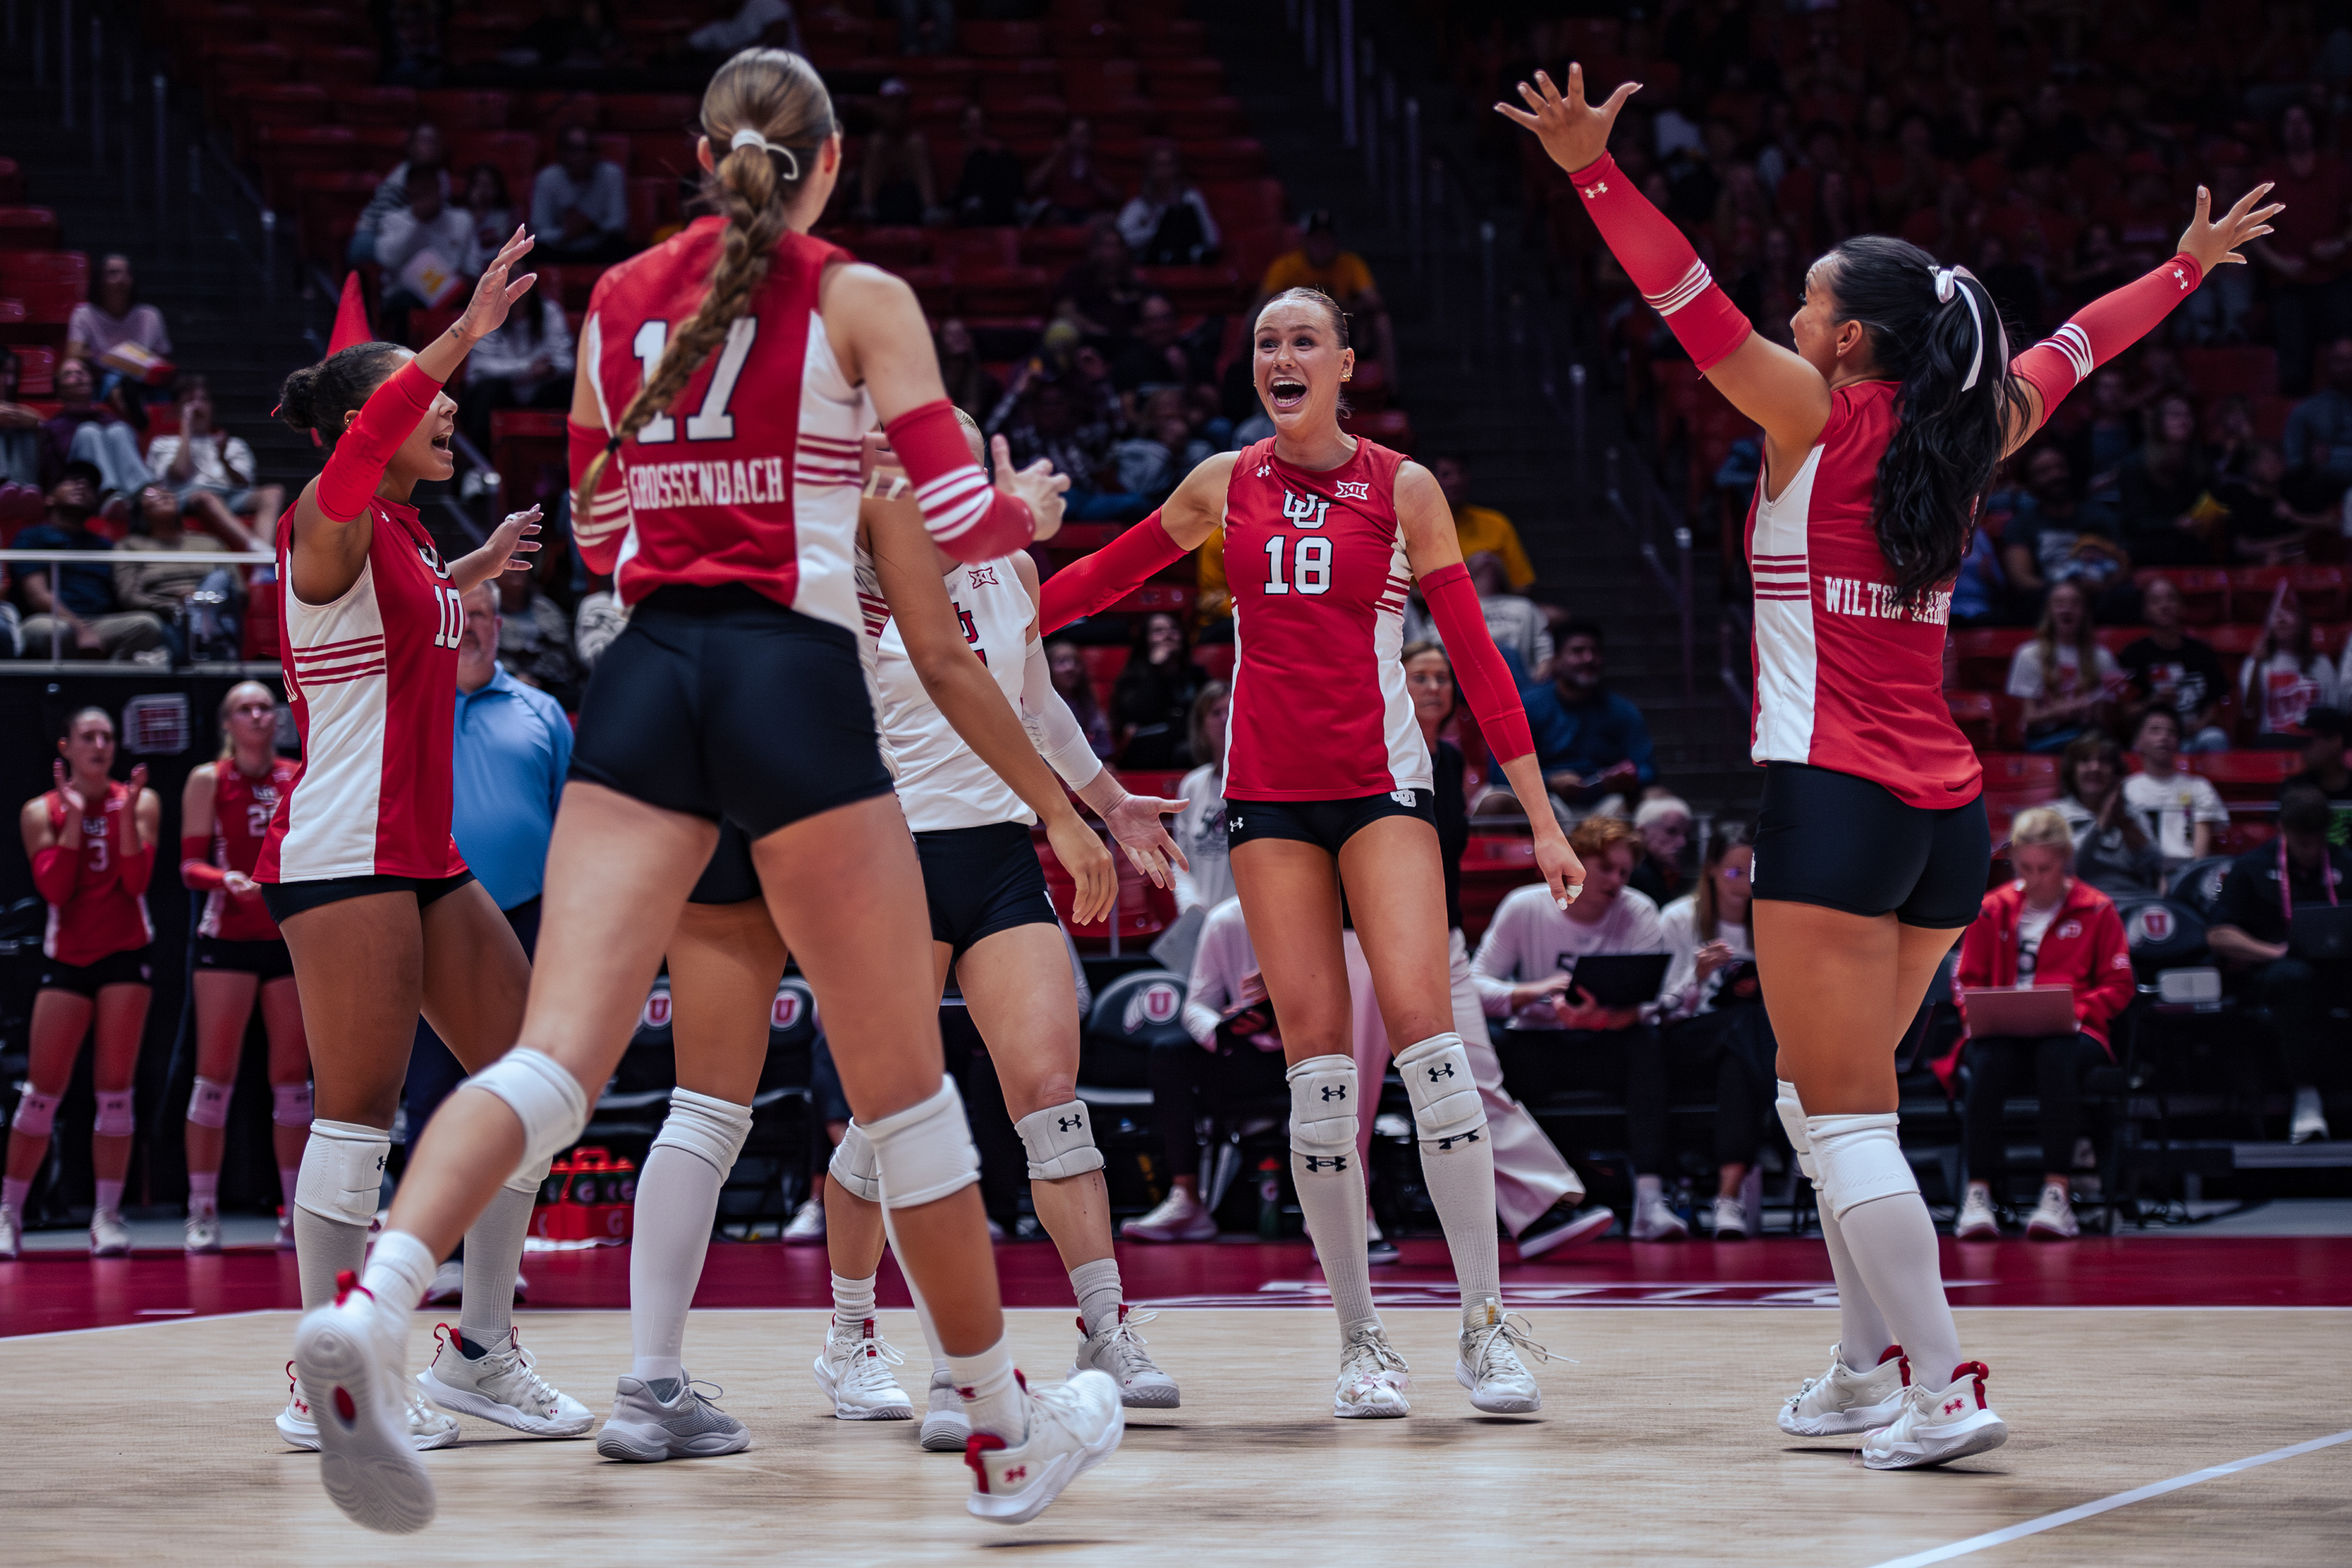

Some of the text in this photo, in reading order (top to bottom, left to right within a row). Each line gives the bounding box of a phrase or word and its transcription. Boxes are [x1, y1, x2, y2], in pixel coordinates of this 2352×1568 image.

[632, 315, 758, 445] 17
[629, 456, 785, 510] GROSSENBACH
[1264, 535, 1333, 595] 18
[434, 584, 464, 650] 10
[87, 837, 109, 872] 3
[649, 999, 669, 1021] U
[775, 1000, 795, 1022] U
[1150, 992, 1171, 1016] U
